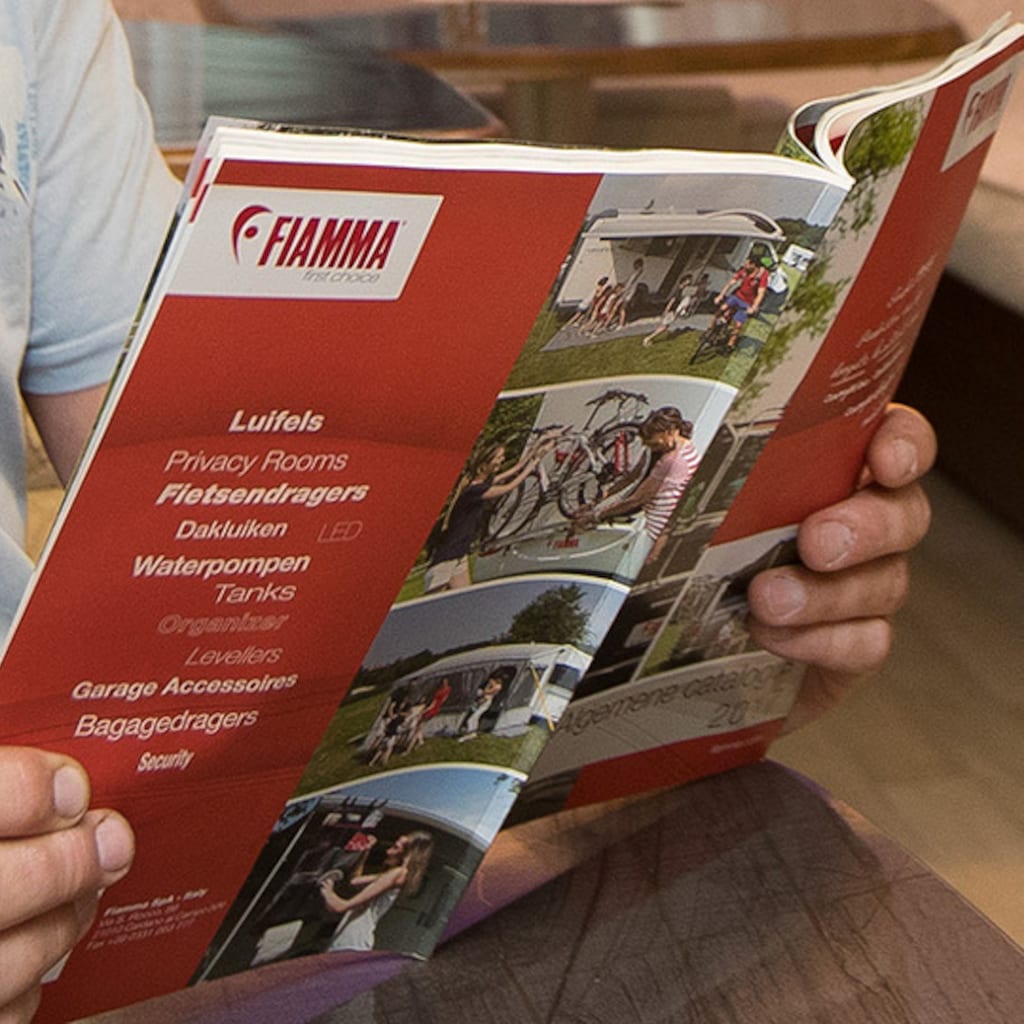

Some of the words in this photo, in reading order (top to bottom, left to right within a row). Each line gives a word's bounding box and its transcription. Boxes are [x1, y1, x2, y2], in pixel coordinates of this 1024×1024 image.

[257, 215, 401, 270] FIAMMA
[229, 409, 324, 432] Luifels
[164, 450, 257, 476] Privacy
[261, 450, 349, 471] Rooms
[156, 483, 369, 507] Fietsendragers
[175, 519, 288, 540] Dakluiken
[318, 521, 363, 543] LED
[132, 554, 311, 580] Waterpompen
[215, 583, 296, 604] Tanks
[157, 612, 290, 637] Organizer
[185, 646, 284, 666] Levellers
[72, 680, 158, 701] Garage
[161, 674, 299, 696] Accessoires
[75, 709, 259, 741] Bagagedragers
[138, 749, 195, 772] Security
